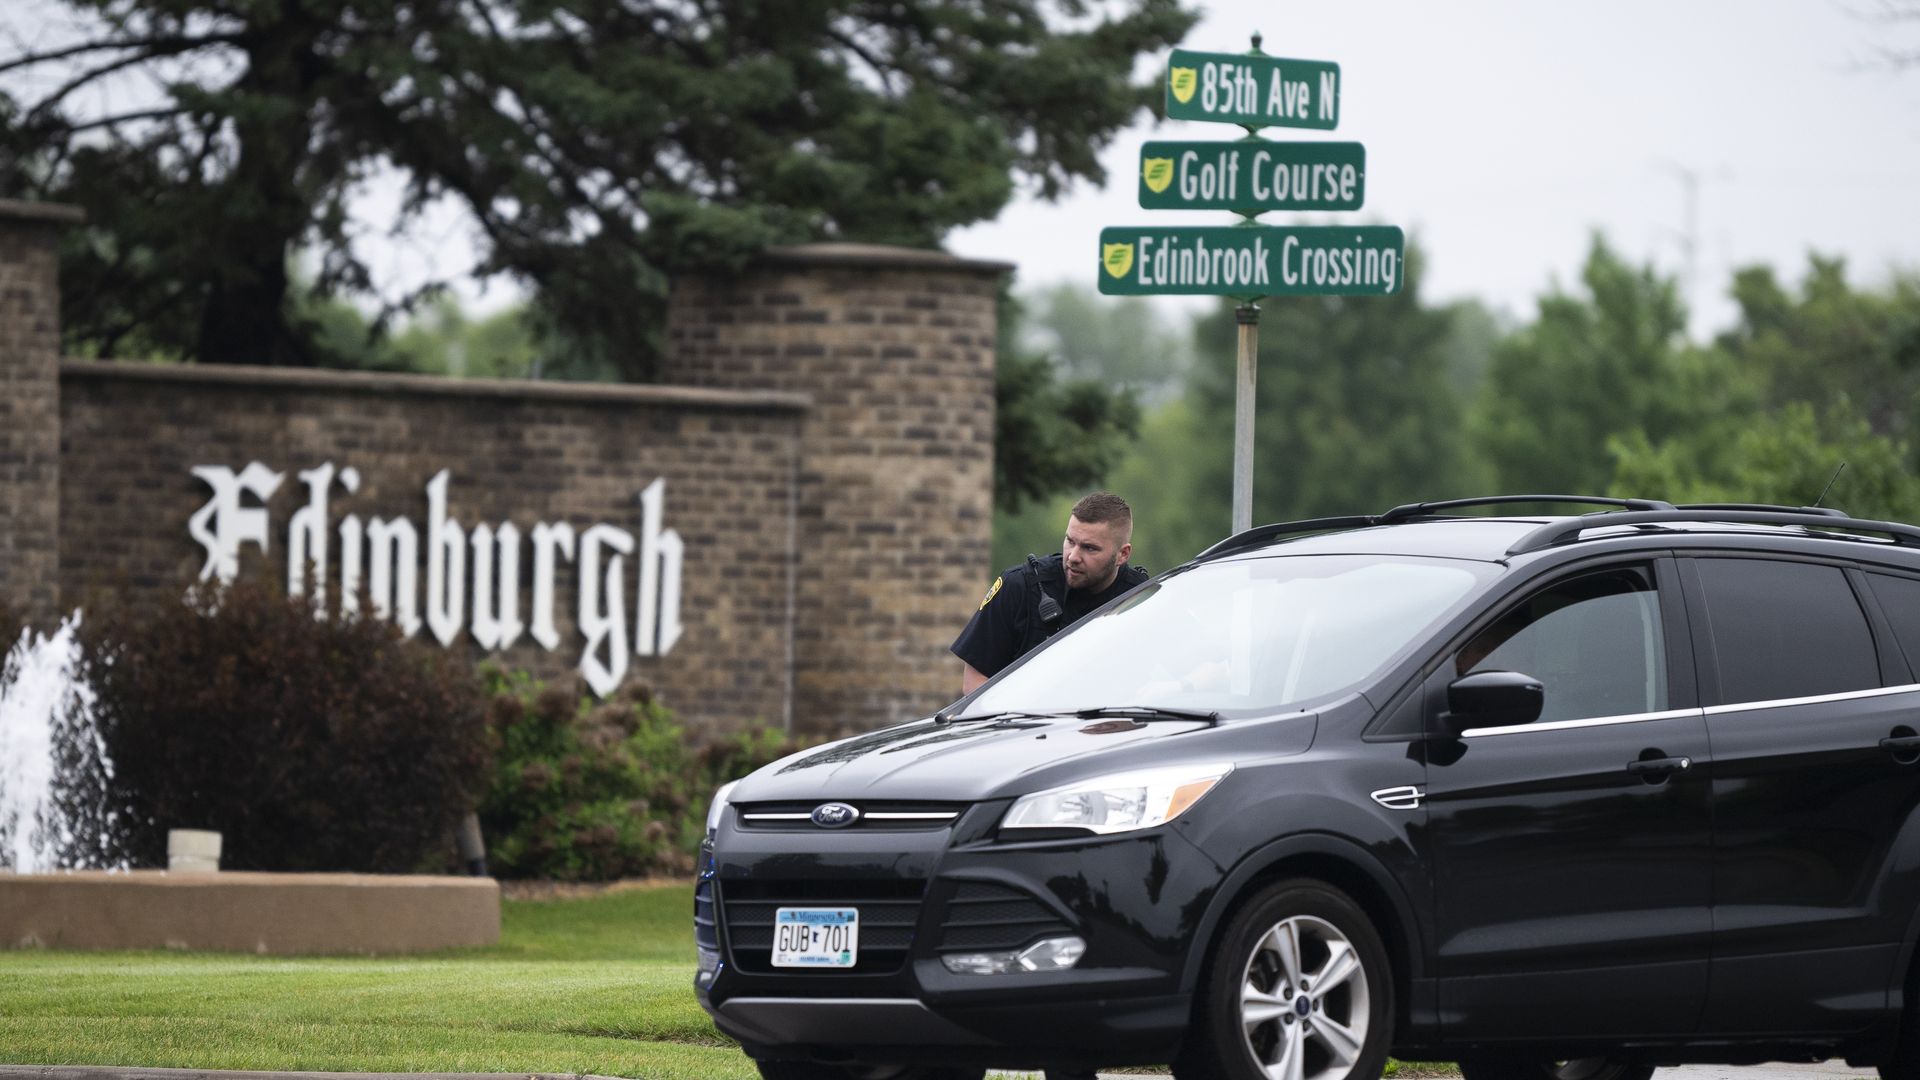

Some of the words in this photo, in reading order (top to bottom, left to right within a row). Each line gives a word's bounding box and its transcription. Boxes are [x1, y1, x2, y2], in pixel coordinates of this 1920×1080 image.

[1202, 62, 1258, 114] 85th
[1267, 67, 1310, 119] Ave
[1319, 71, 1336, 120] N
[1180, 150, 1239, 200] Golf
[1252, 150, 1357, 201] Course
[1138, 236, 1269, 285] Edinbrook
[1282, 236, 1397, 293] Crossing
[819, 806, 846, 821] Ford
[779, 925, 810, 952] GUB
[823, 925, 850, 953] 701
